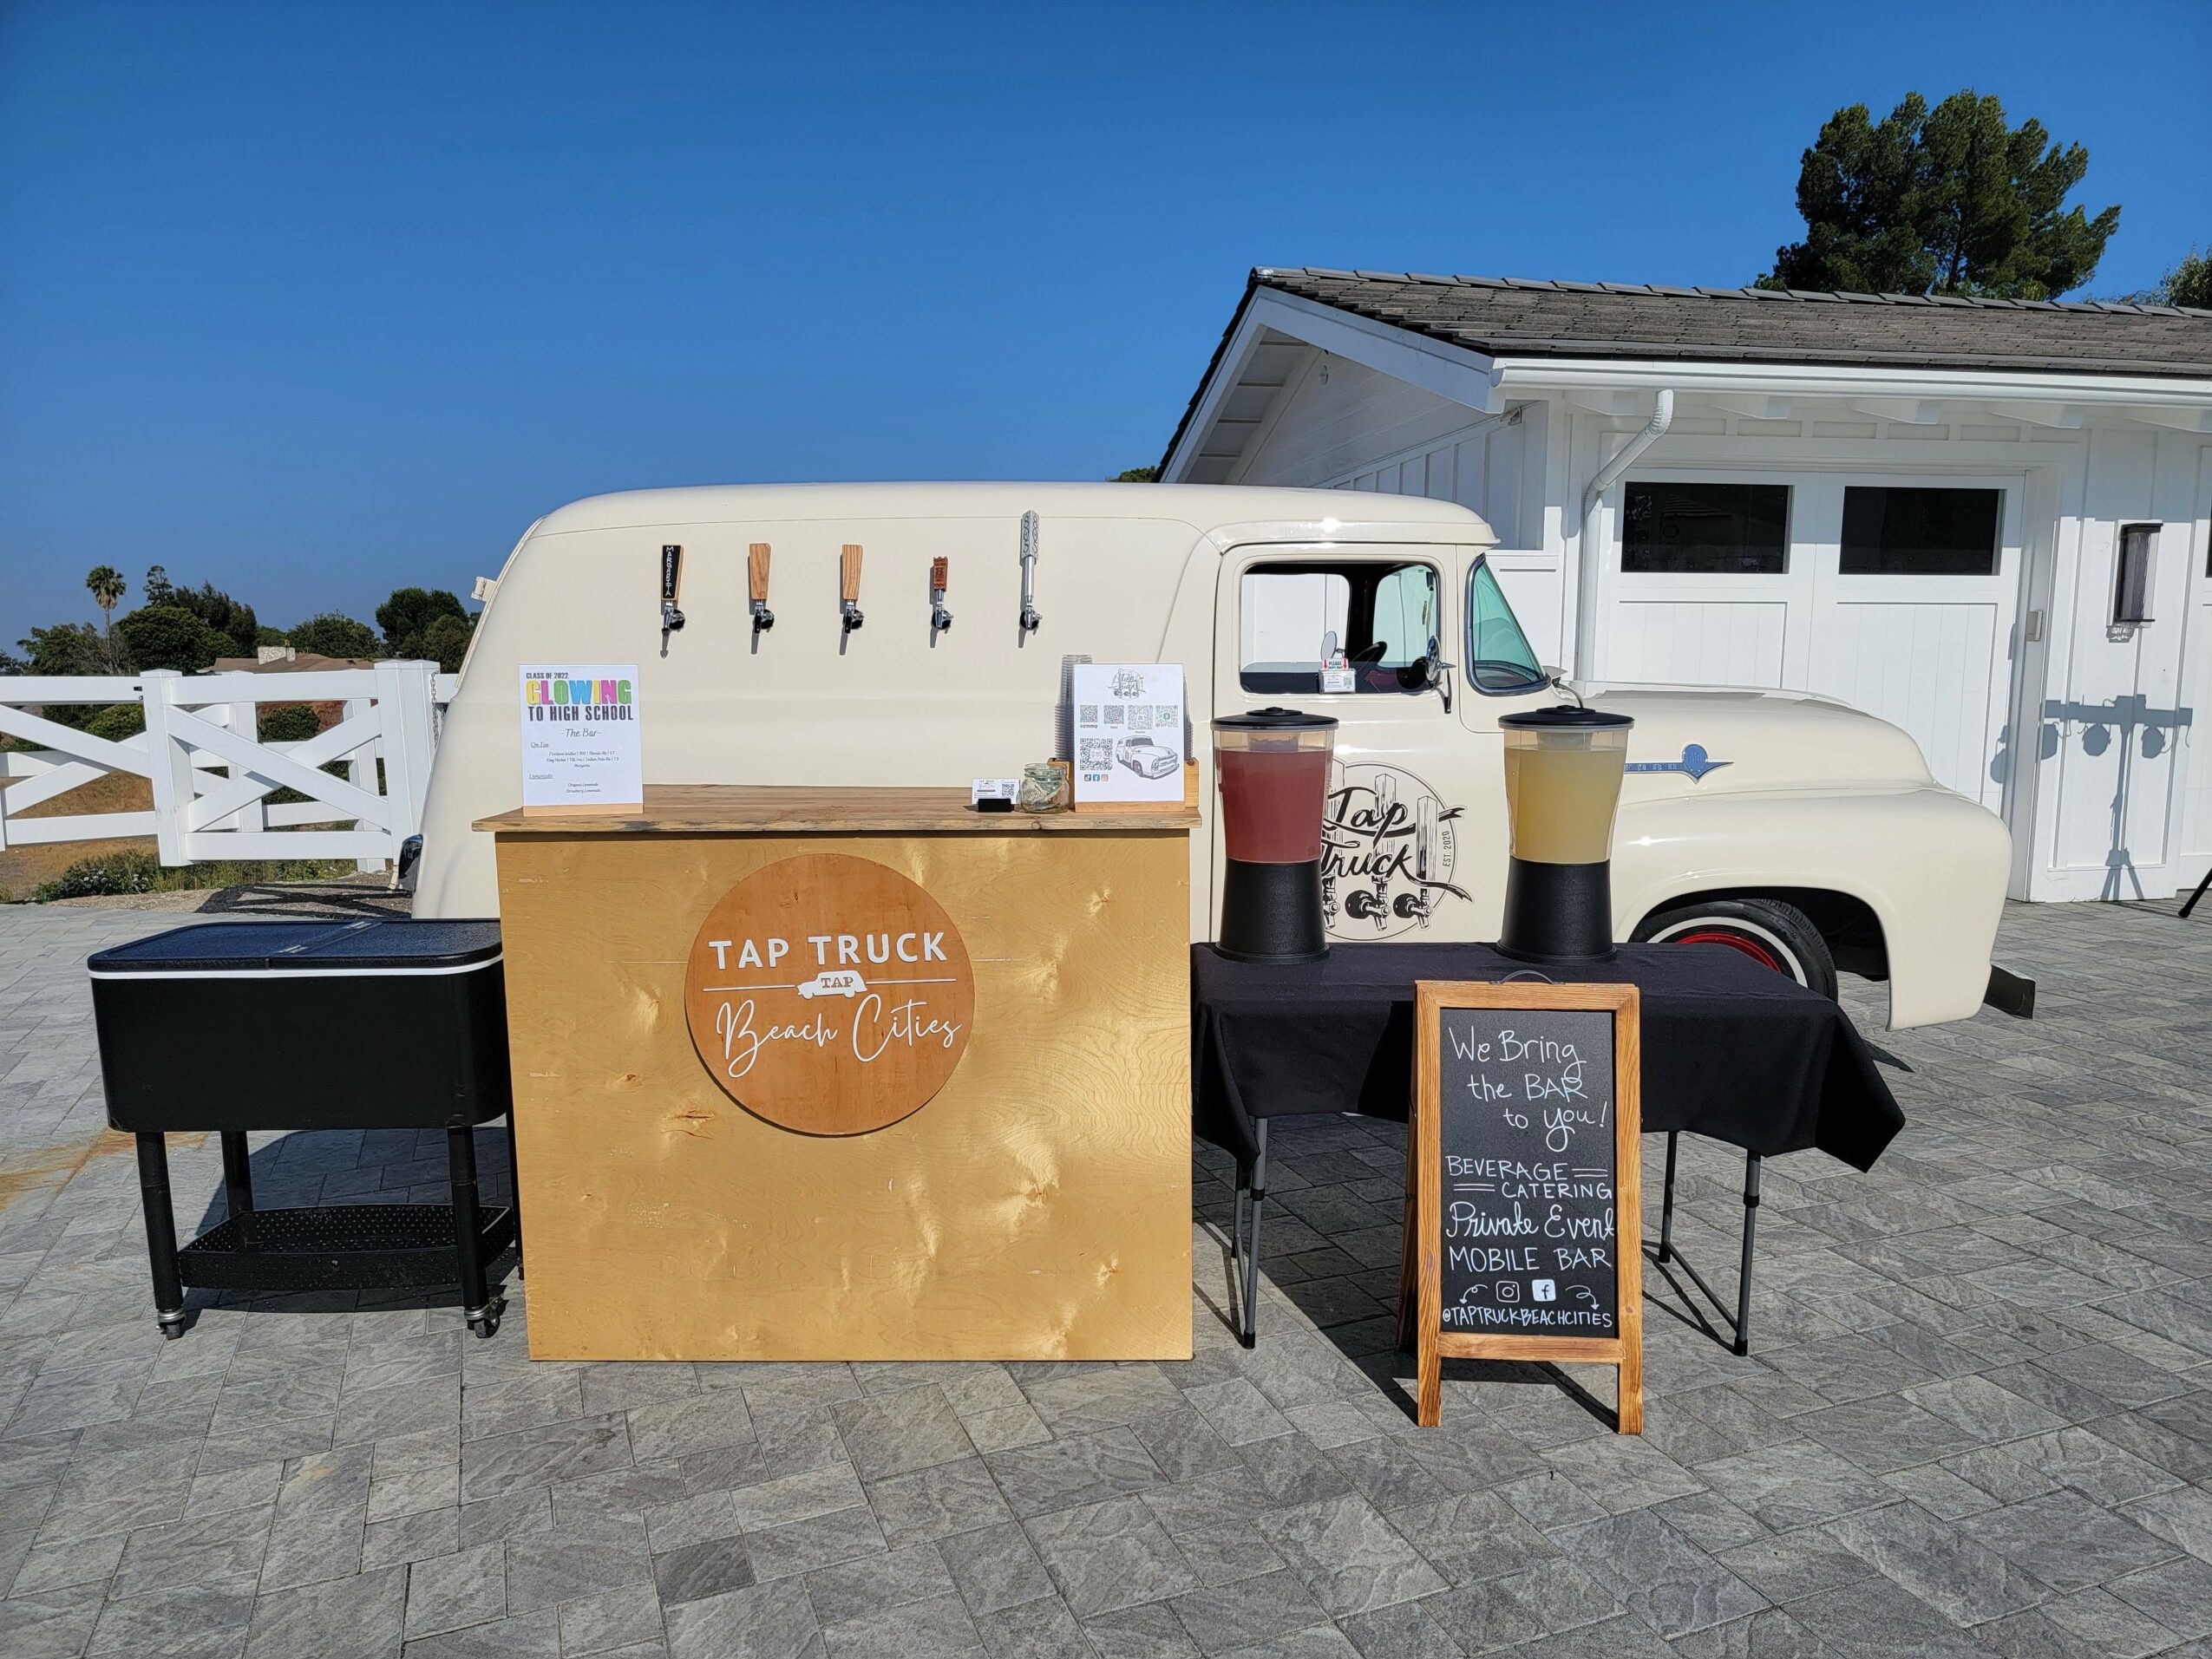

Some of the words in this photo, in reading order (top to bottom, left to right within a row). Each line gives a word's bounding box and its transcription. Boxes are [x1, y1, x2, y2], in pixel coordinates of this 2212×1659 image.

[664, 546, 674, 597] MARGARITA
[526, 679, 632, 706] GLOWING
[527, 706, 544, 722] TO
[550, 705, 579, 722] HIGH
[586, 705, 633, 721] SCHOOL
[1325, 786, 1410, 846] Tap
[1442, 830, 1451, 852] 2020
[1321, 840, 1414, 878] Truck
[1442, 853, 1451, 867] EST.
[708, 938, 790, 970] TAP
[808, 931, 948, 966] TRUCK
[820, 976, 854, 989] TAP
[716, 998, 839, 1079] Beach
[851, 993, 962, 1063] Cities
[1448, 1025, 1491, 1063] We
[1498, 1029, 1587, 1083] Bring
[1467, 1074, 1513, 1102] the
[1524, 1074, 1589, 1103] BAR
[1502, 1107, 1529, 1130] to
[1445, 1155, 1568, 1181] BEVERAGE
[1501, 1181, 1613, 1199] CATERING
[1445, 1201, 1540, 1238] Private
[1543, 1204, 1615, 1240] Event
[1449, 1246, 1541, 1273] MOBILE
[1553, 1248, 1612, 1271] BAR
[1443, 1305, 1613, 1329] @TAPTRUCKBEACHCITIES
